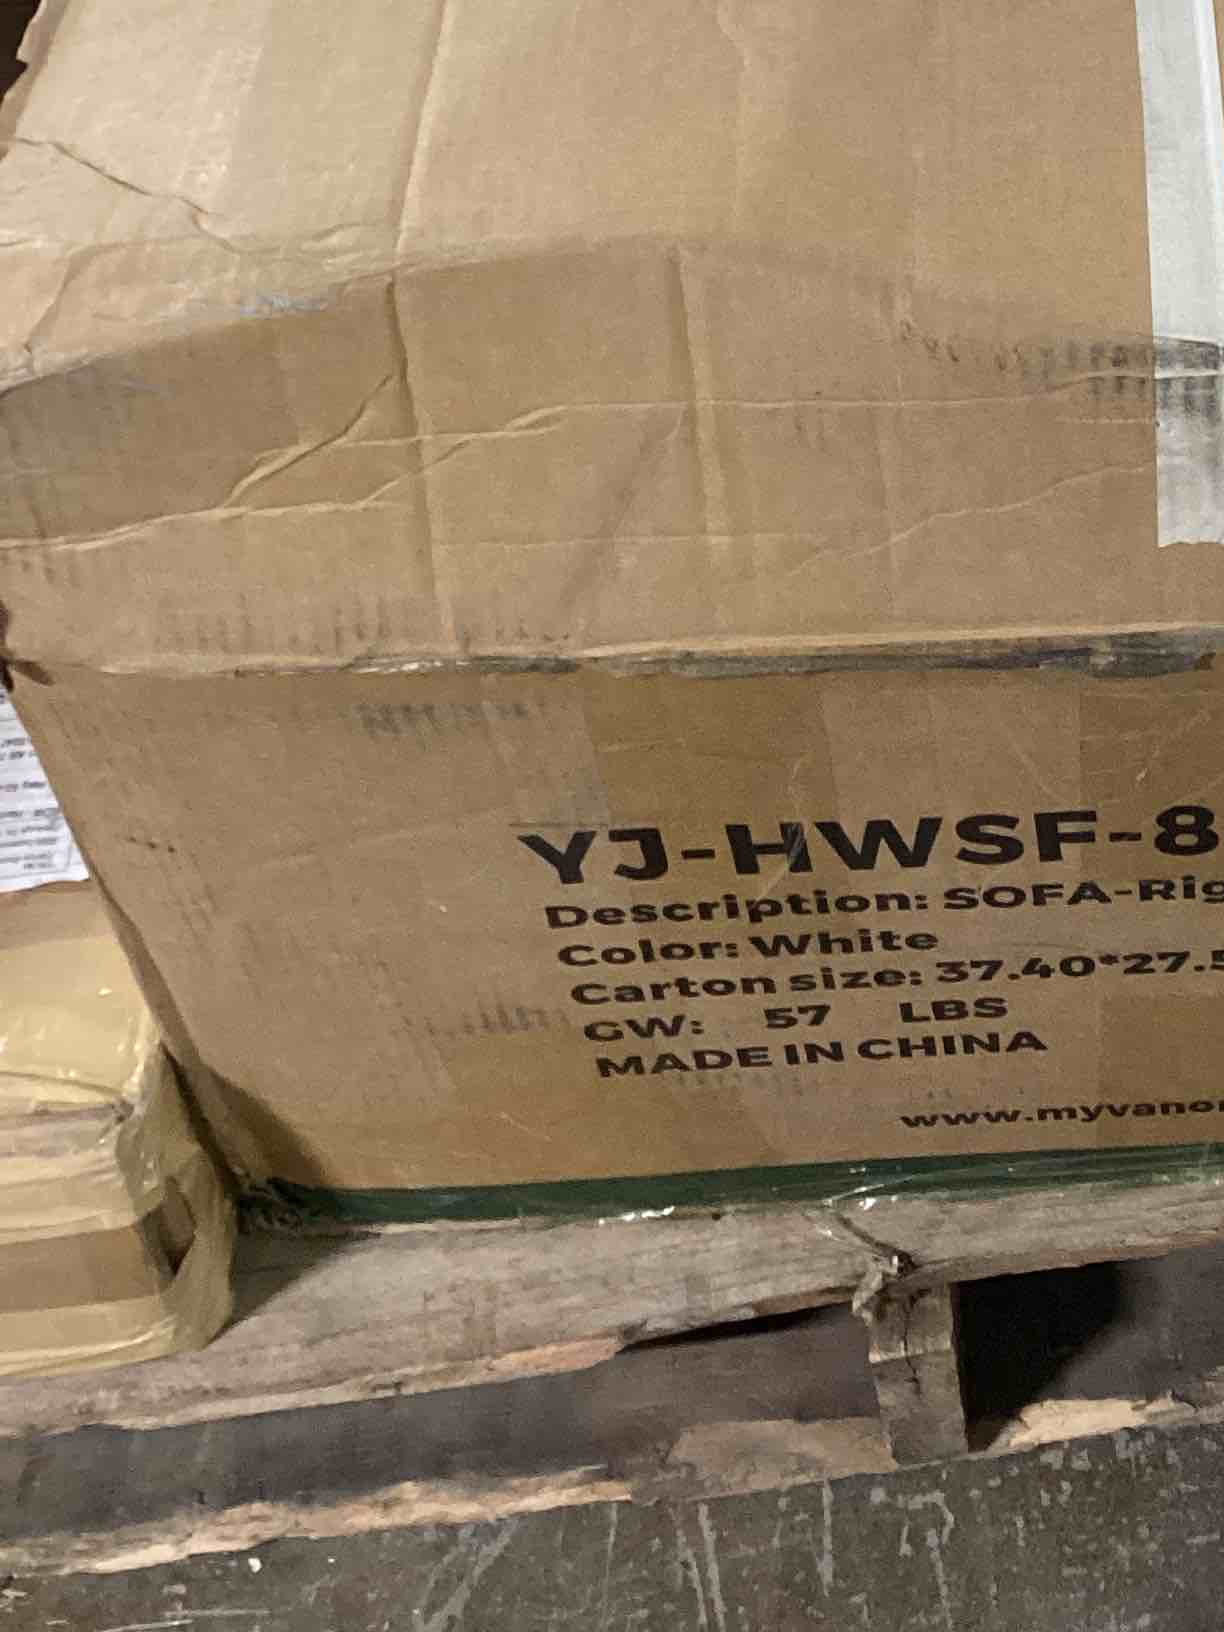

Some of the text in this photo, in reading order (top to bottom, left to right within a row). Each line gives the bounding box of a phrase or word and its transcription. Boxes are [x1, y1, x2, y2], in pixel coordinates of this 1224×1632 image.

[545, 884, 929, 930] Description:
[557, 926, 940, 967] Color: White
[569, 973, 779, 1007] Carton
[787, 964, 923, 993] size:
[765, 1004, 833, 1030] 57
[898, 997, 1010, 1024] LBS
[595, 1029, 1049, 1079] MADE IN CHINA
